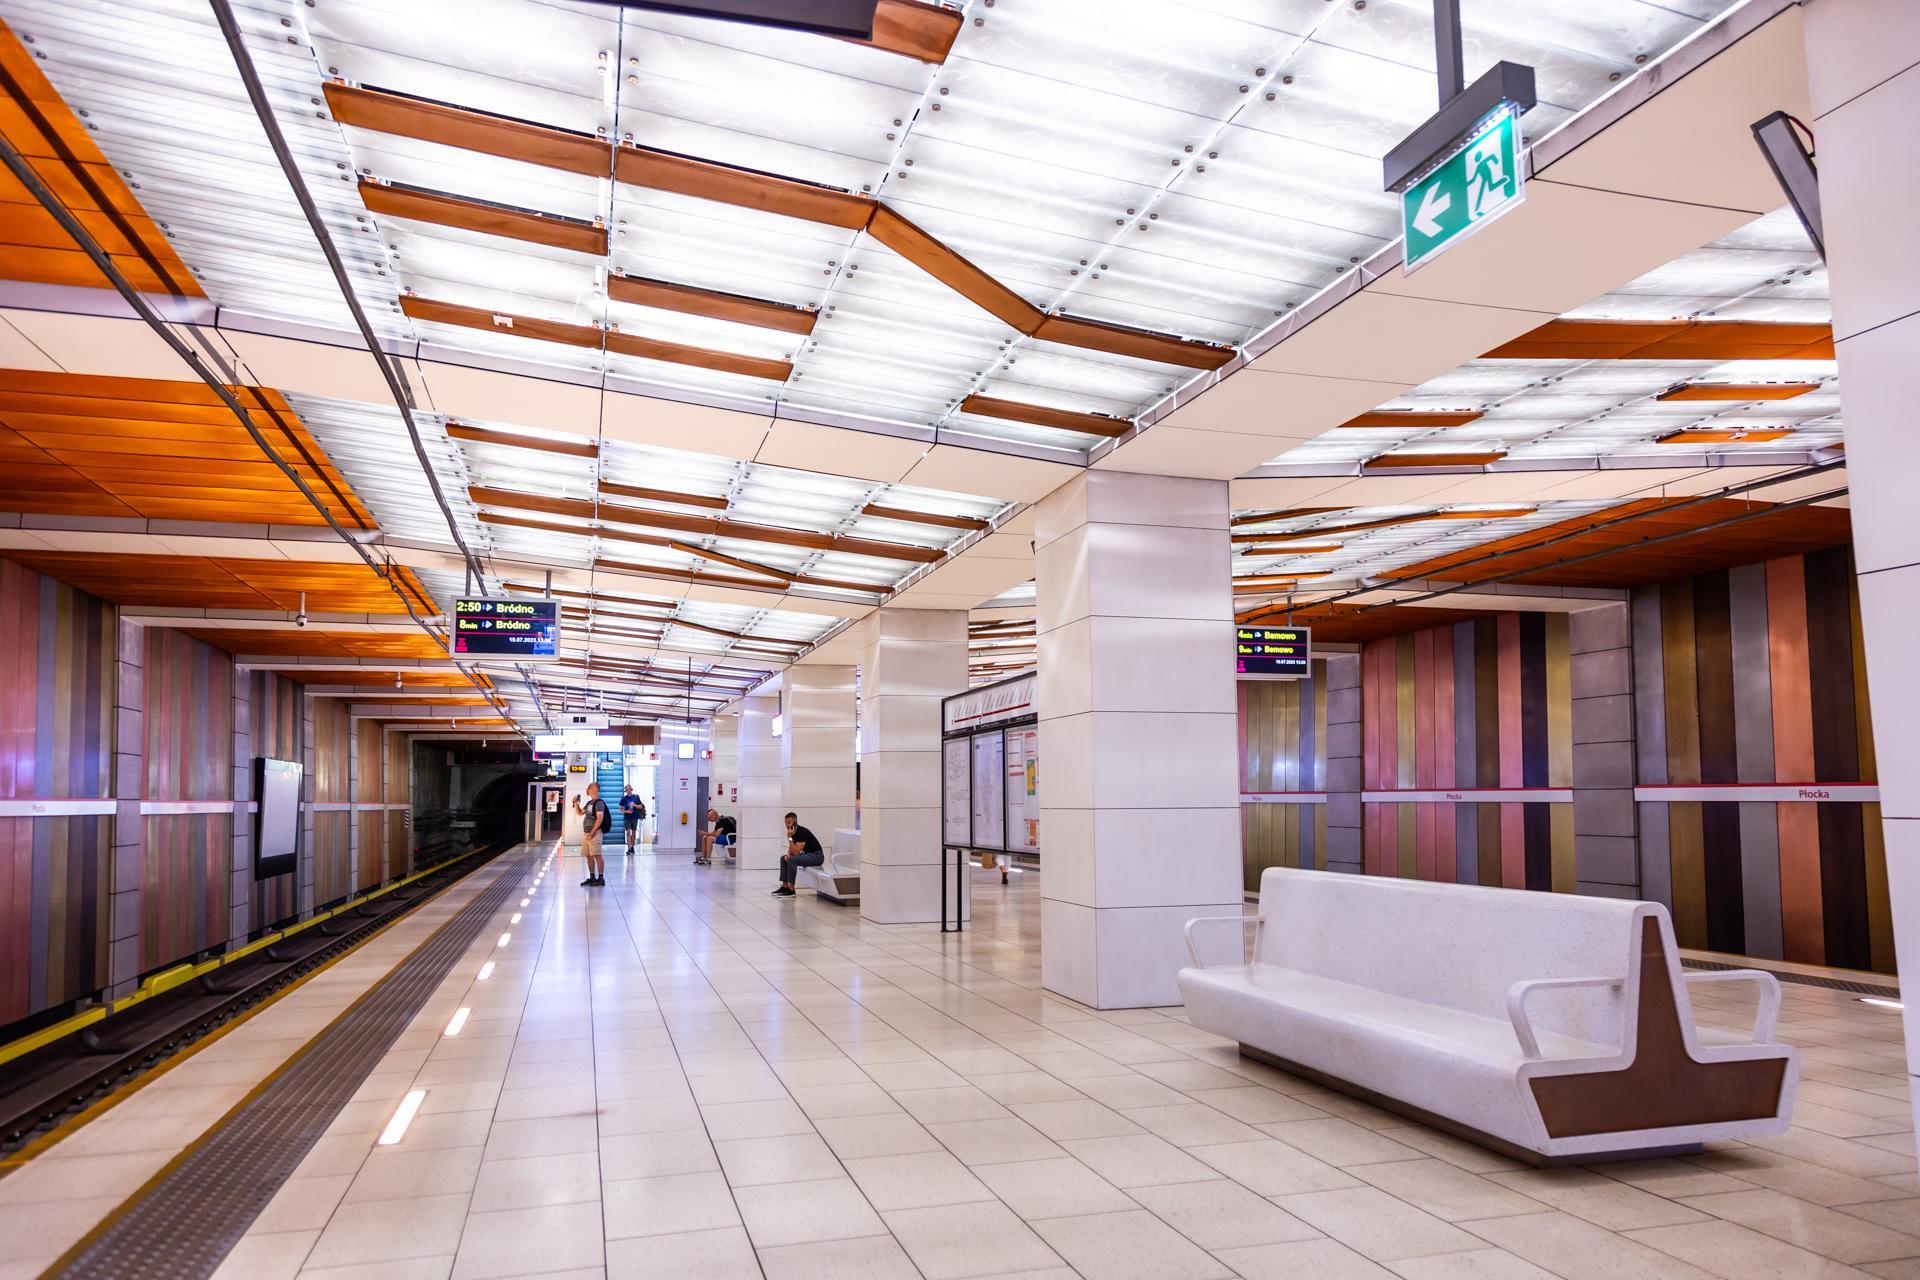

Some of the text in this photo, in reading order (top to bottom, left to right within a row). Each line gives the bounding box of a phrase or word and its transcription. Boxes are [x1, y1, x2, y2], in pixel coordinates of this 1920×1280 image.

[457, 602, 534, 614] 2:50 Bródno
[459, 620, 530, 630] 8min Bródno
[1264, 631, 1296, 641] Bemowo
[1264, 645, 1294, 654] Bemowo
[1798, 789, 1830, 799] Płocka
